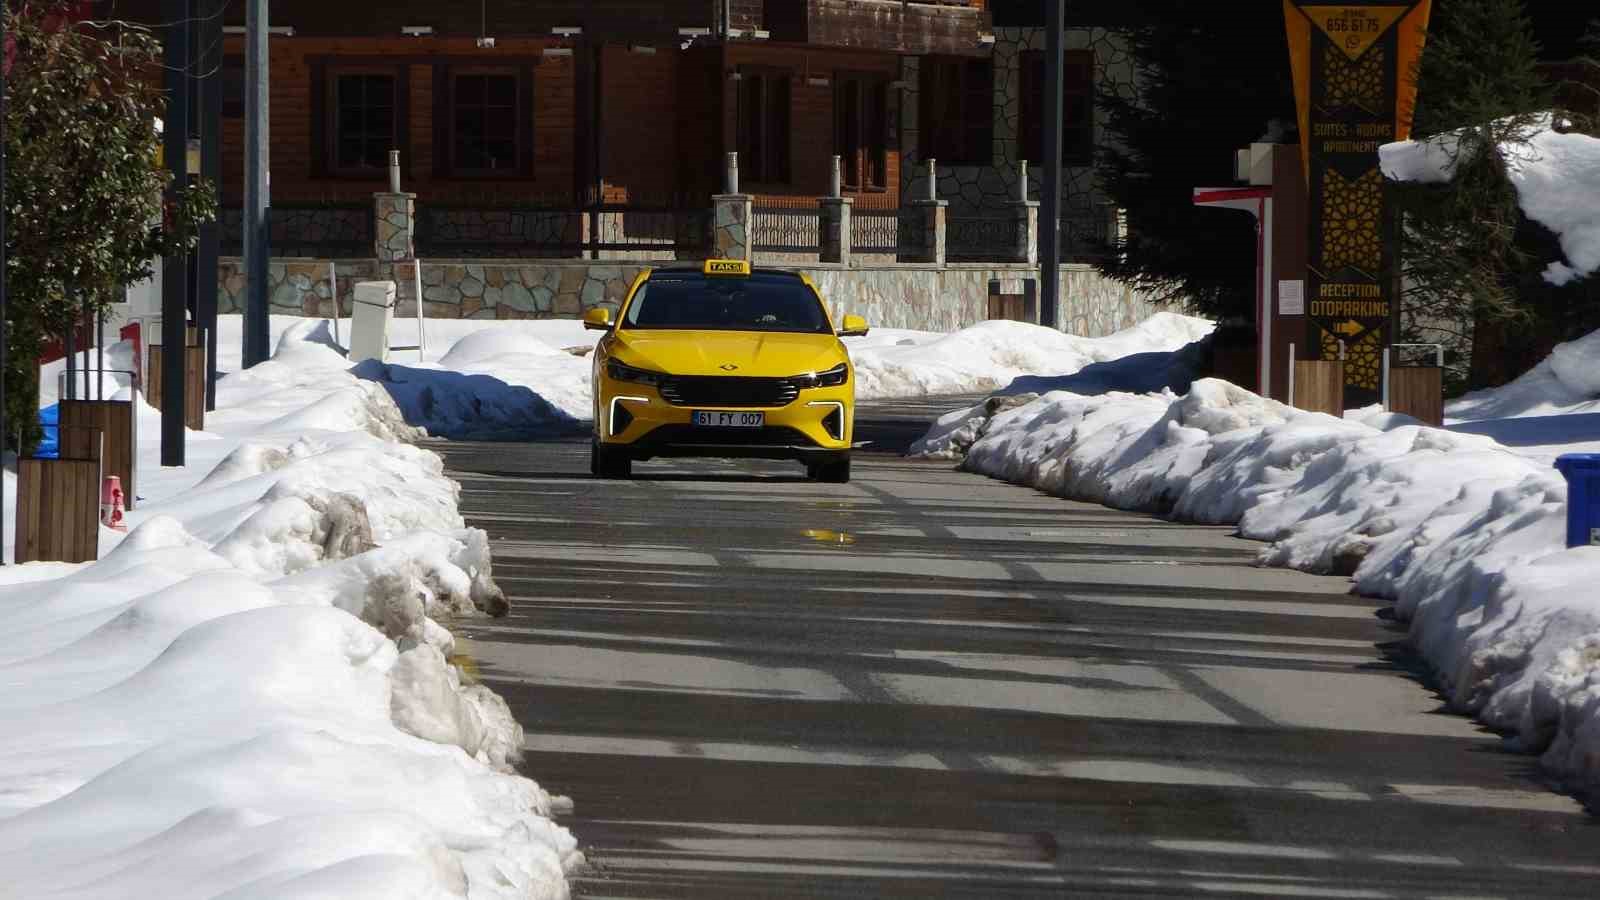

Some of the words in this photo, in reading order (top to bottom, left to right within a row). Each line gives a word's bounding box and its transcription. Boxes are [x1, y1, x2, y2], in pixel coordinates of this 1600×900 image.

[1327, 18, 1348, 31] 856
[1313, 123, 1346, 136] SUITES
[710, 262, 743, 273] TAKSI
[1320, 283, 1380, 297] RECEPTION
[1311, 300, 1389, 317] OTOPARKING
[700, 413, 711, 424] 61
[720, 413, 733, 424] FY
[741, 413, 762, 425] 007
